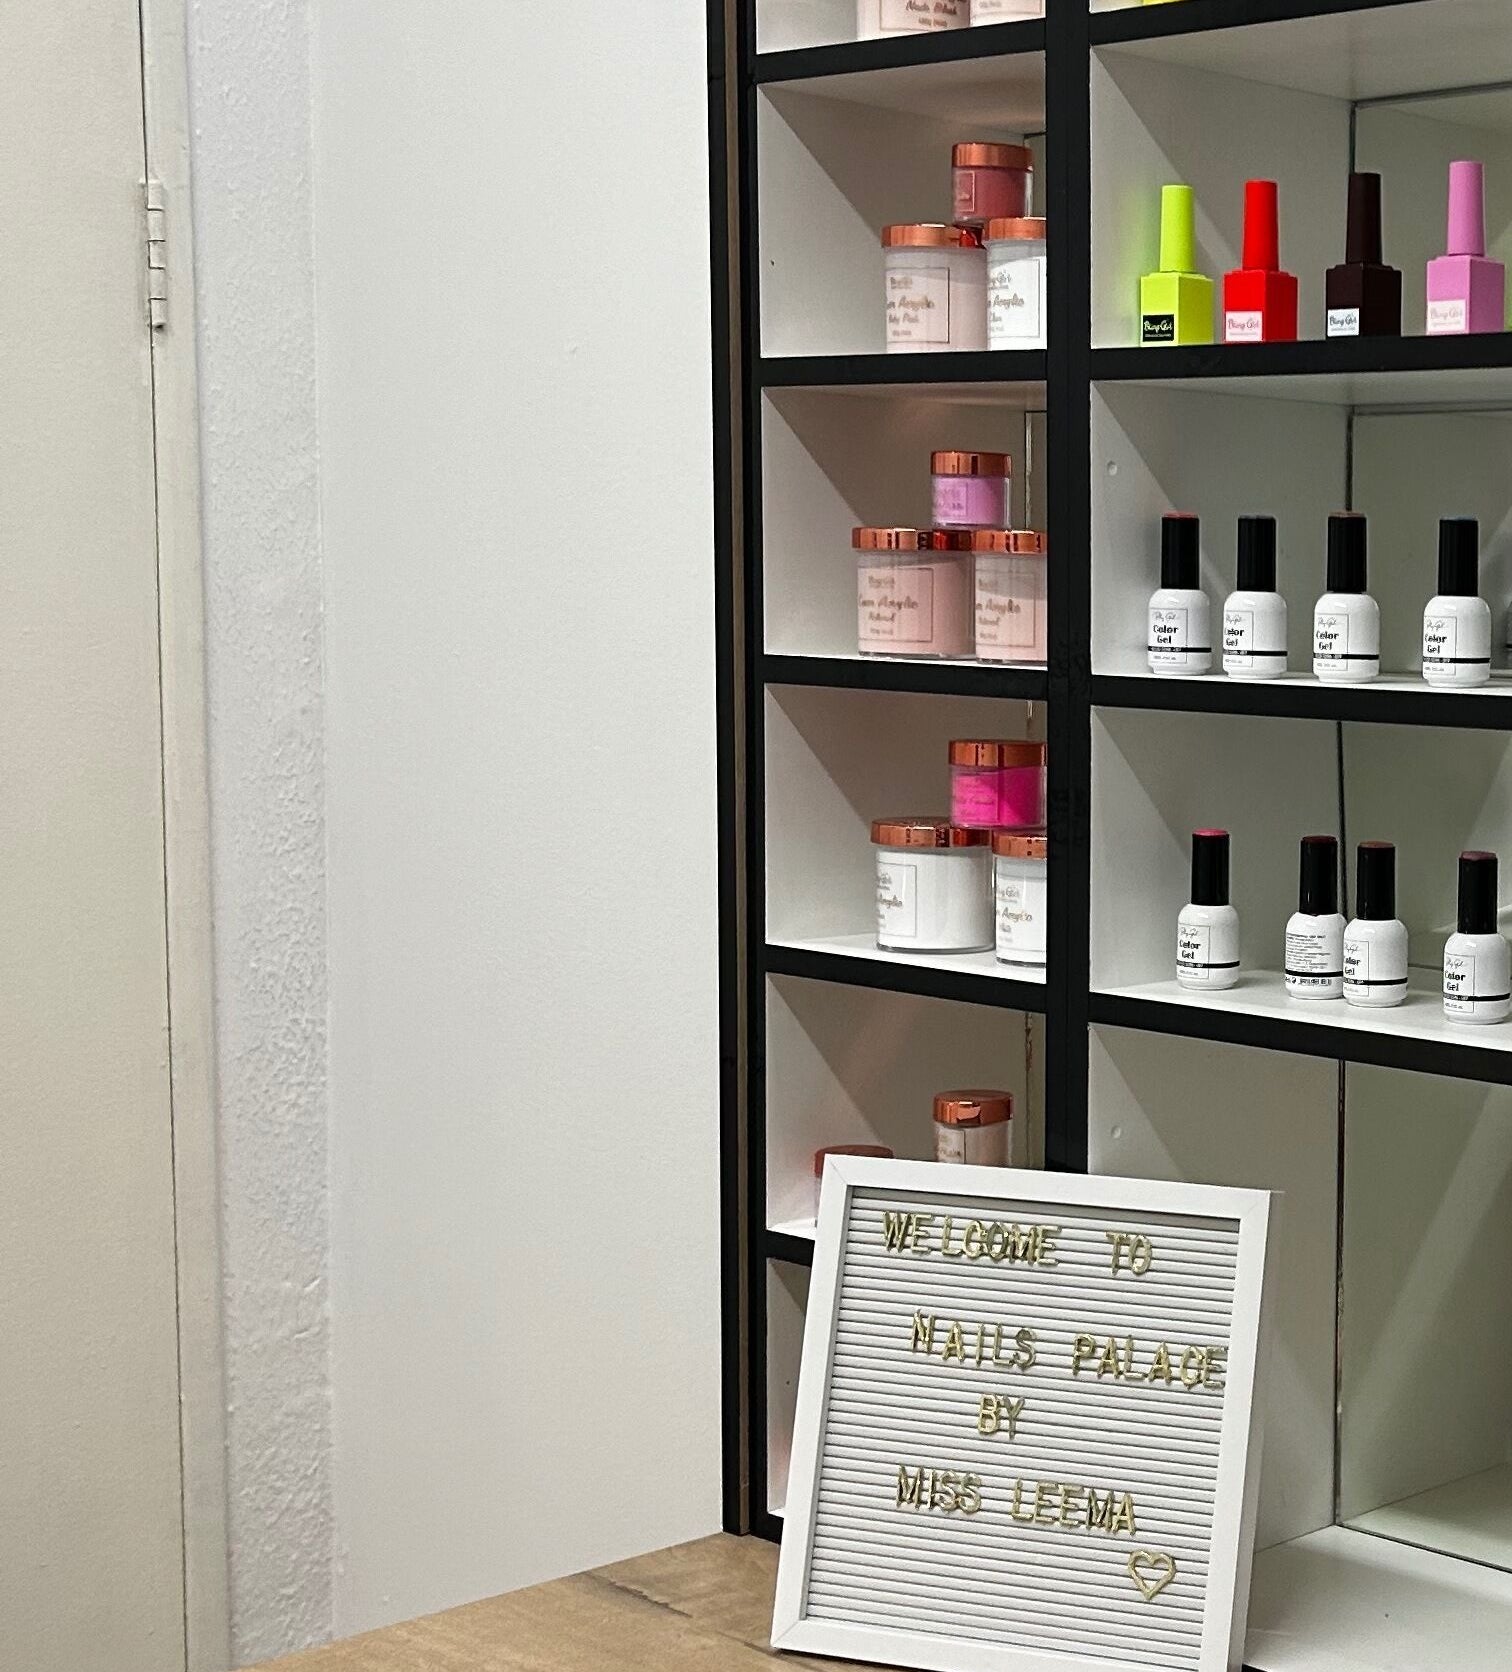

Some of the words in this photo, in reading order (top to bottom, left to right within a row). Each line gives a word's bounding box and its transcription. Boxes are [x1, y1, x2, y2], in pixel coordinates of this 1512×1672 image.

[1153, 624, 1179, 635] Color
[1157, 635, 1172, 645] Gel
[1316, 630, 1339, 640] Color
[1319, 641, 1332, 651] Gel
[881, 1210, 1062, 1267] WELCOME
[1105, 1230, 1153, 1276] TO
[911, 1308, 1037, 1370] NAILS
[1071, 1332, 1229, 1391] PALACE
[976, 1392, 1026, 1439] BY
[895, 1463, 983, 1515] MISS
[1010, 1477, 1138, 1537] LEEMA
